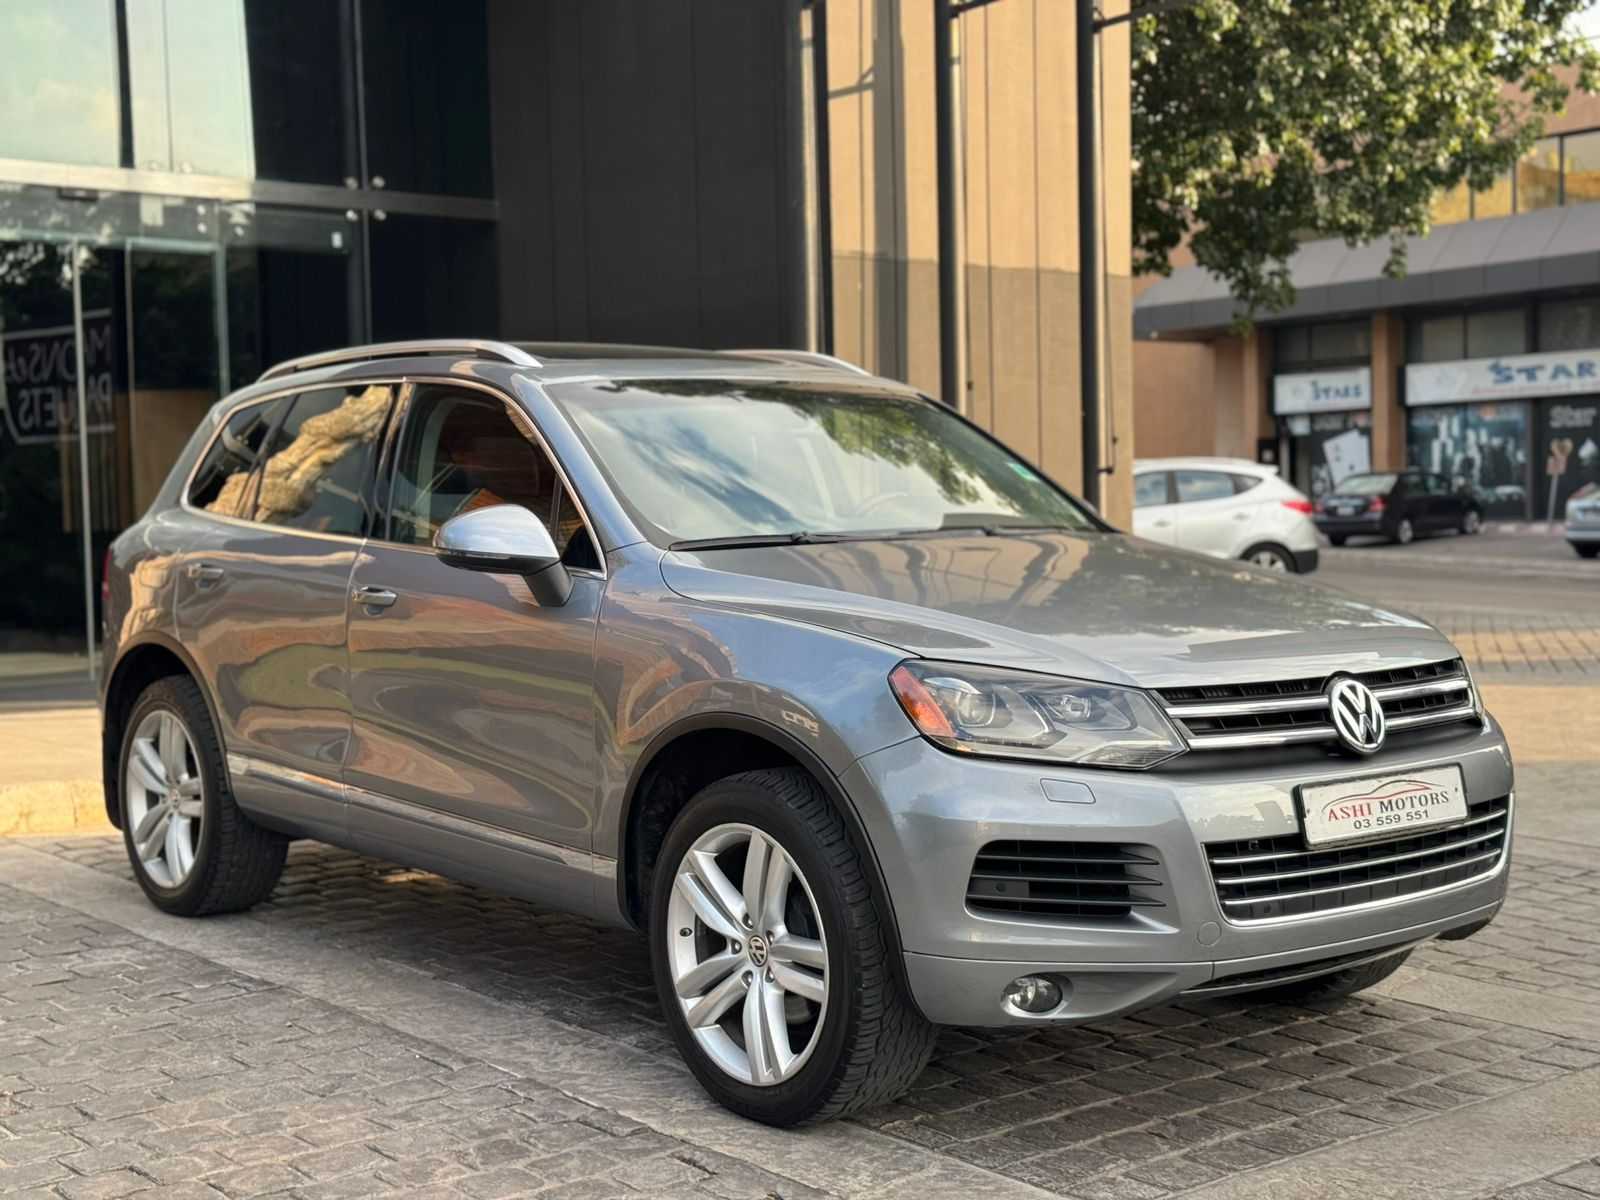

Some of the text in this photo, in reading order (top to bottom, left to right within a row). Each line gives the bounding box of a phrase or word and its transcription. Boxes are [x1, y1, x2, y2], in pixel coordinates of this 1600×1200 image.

[1328, 791, 1449, 821] ASHI MOTORS
[1353, 810, 1429, 829] 03 559 551
